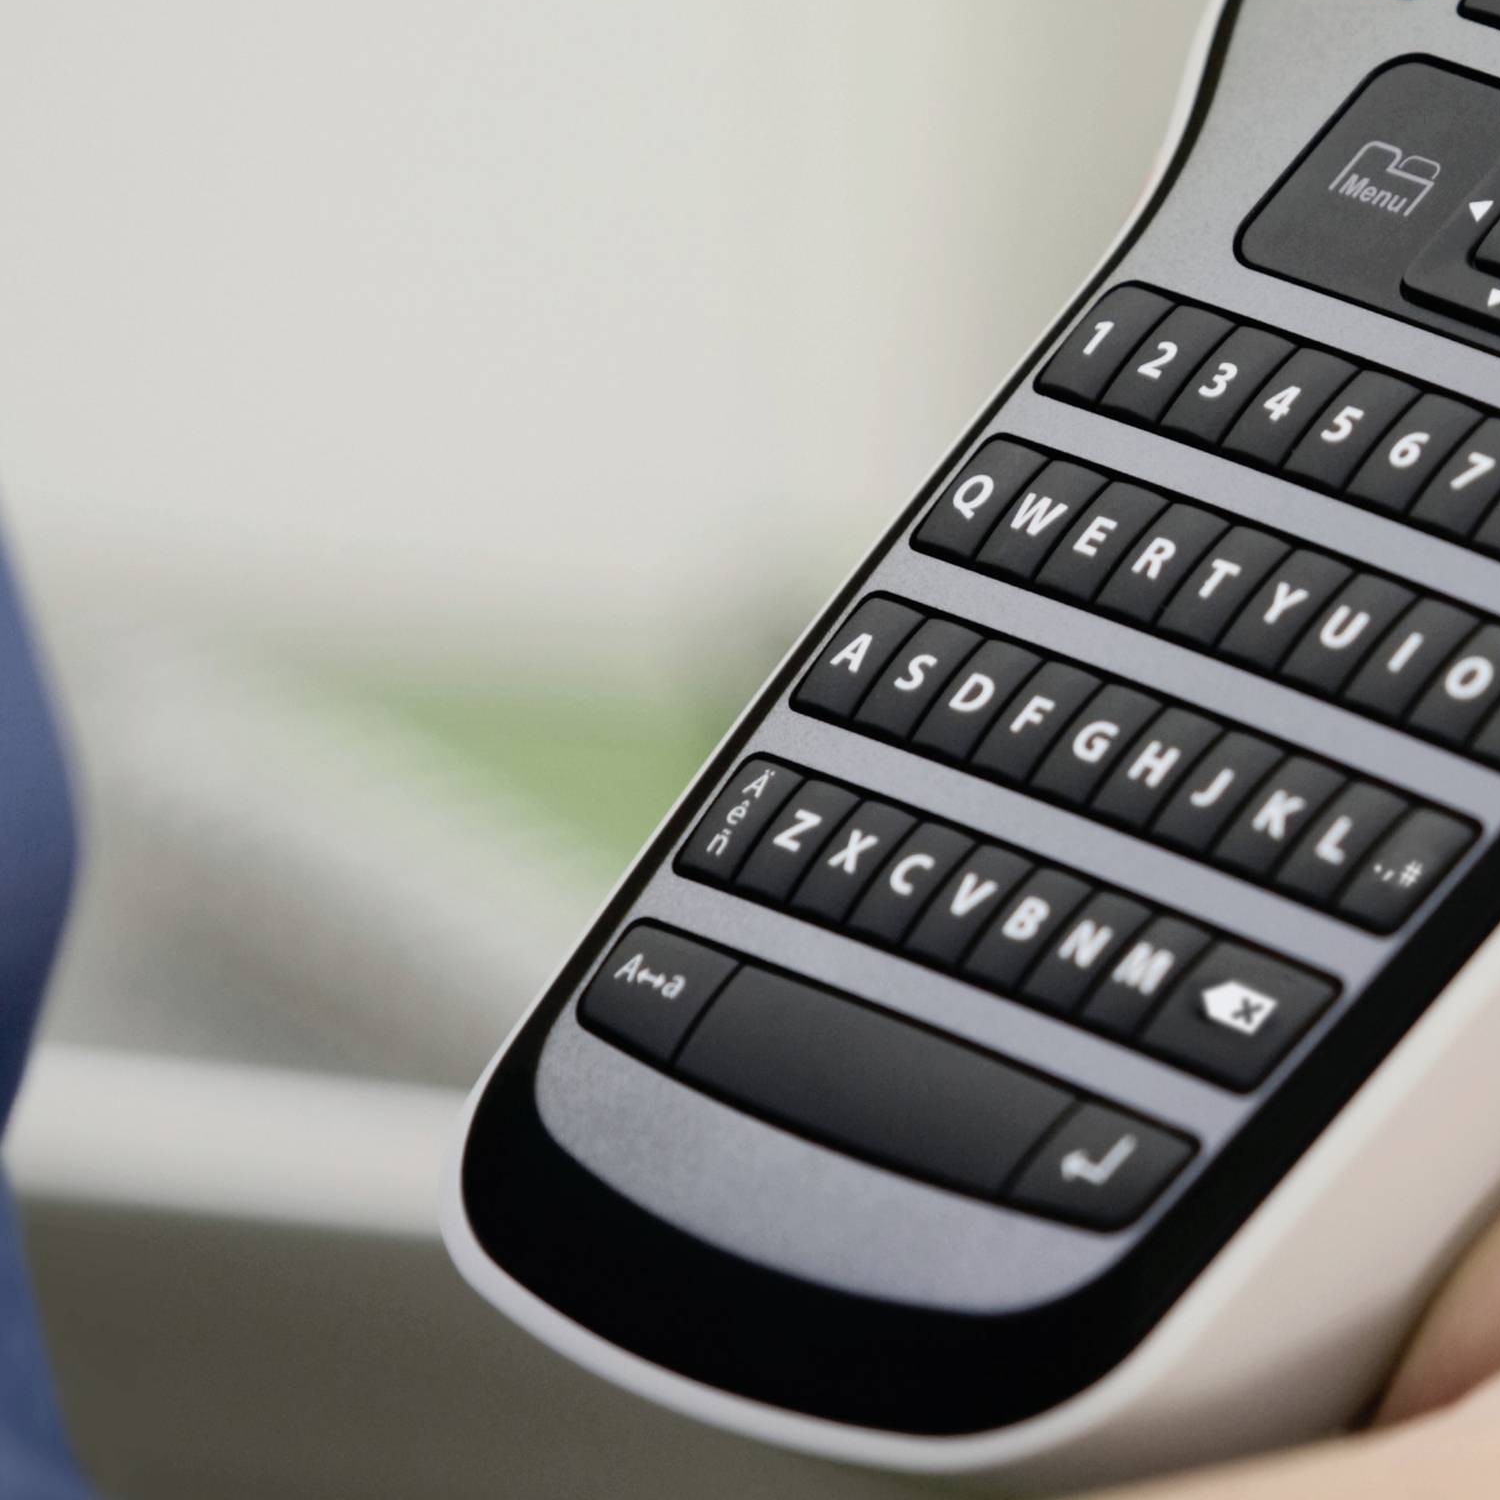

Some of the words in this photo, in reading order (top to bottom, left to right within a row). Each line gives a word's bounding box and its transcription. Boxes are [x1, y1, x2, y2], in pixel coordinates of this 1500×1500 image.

[1339, 173, 1407, 213] Menu
[1082, 320, 1115, 356] 1
[1136, 341, 1178, 380] 2
[1198, 362, 1238, 399] 3
[1263, 385, 1302, 422] 4
[1320, 405, 1365, 443] 5
[1388, 431, 1430, 468] 6
[1450, 451, 1496, 490] 7
[952, 474, 995, 520] Q
[1010, 492, 1069, 536] W
[1072, 515, 1118, 557] E
[1131, 536, 1177, 580] R
[1198, 558, 1242, 599] T
[1263, 581, 1309, 624] Y
[1320, 605, 1370, 649] U
[1387, 632, 1423, 673] I
[1445, 656, 1494, 699] O
[829, 632, 873, 673] A
[893, 653, 938, 691] S
[948, 672, 995, 712] D
[1009, 695, 1056, 733] F
[1072, 720, 1119, 763] G
[1127, 740, 1180, 787] H
[1190, 768, 1235, 807] J
[1252, 789, 1304, 839] K
[1315, 815, 1352, 864] L
[772, 808, 822, 853] Z
[828, 829, 878, 874] X
[889, 853, 935, 896] C
[950, 872, 997, 916] V
[1002, 896, 1050, 941] B
[1059, 920, 1112, 967] N
[1115, 943, 1172, 992] M
